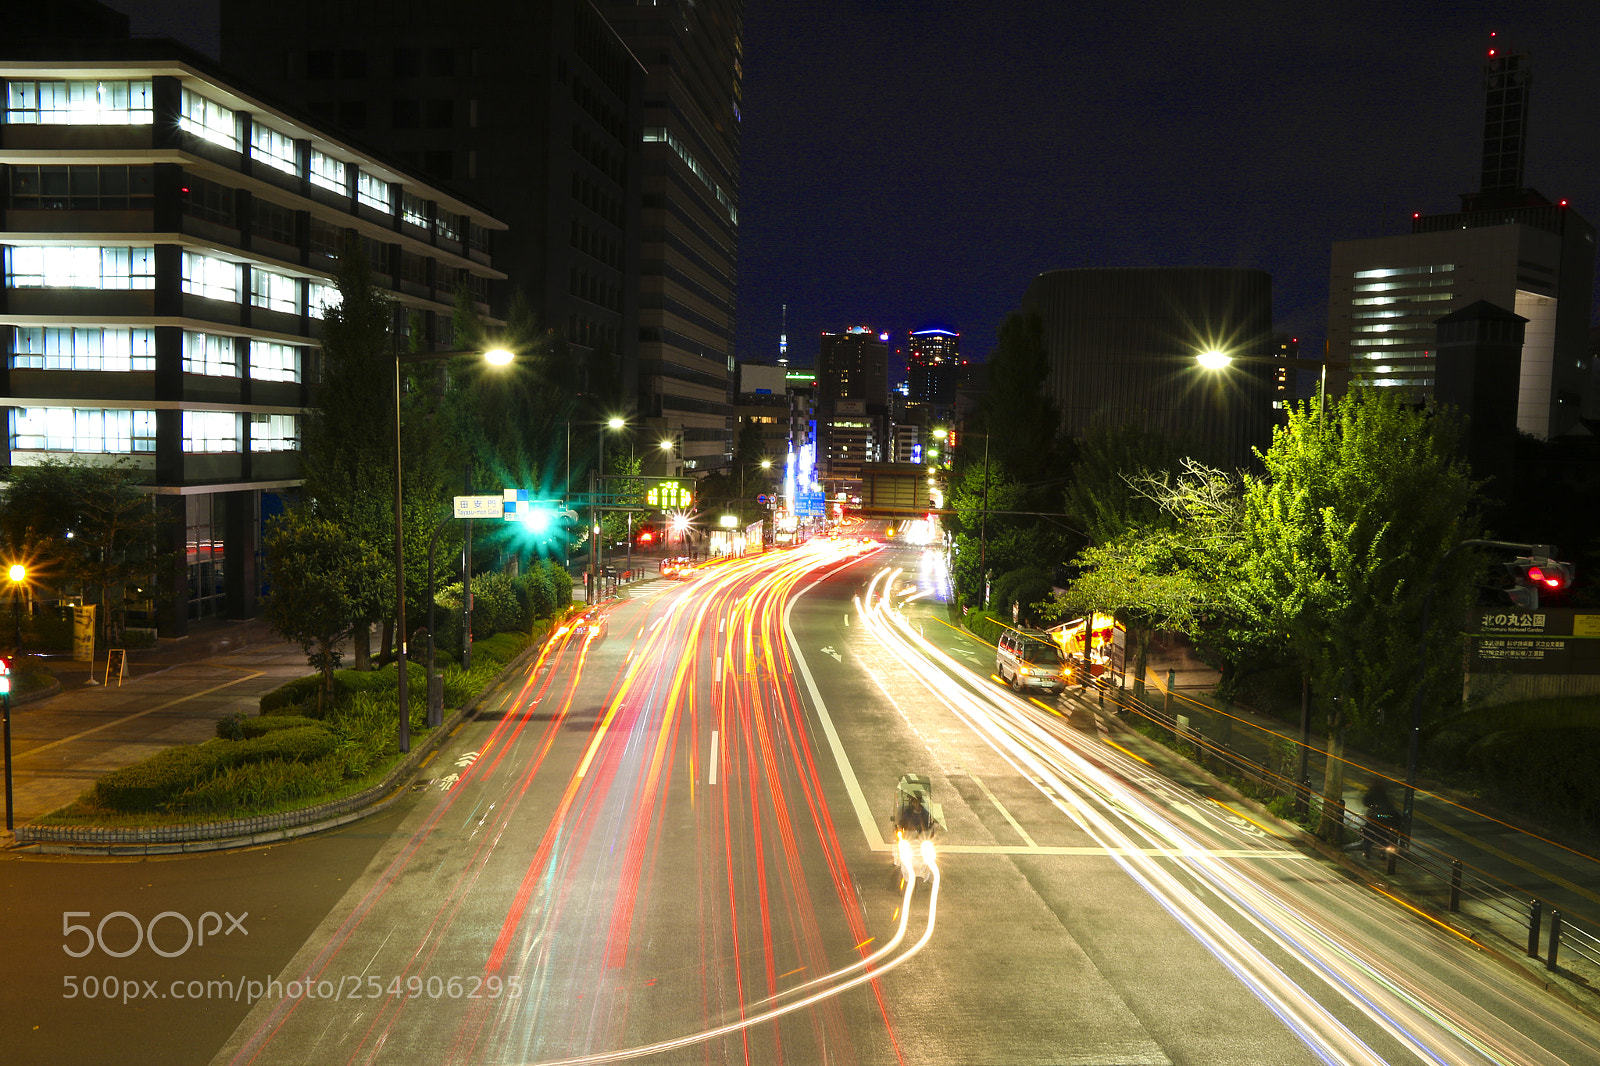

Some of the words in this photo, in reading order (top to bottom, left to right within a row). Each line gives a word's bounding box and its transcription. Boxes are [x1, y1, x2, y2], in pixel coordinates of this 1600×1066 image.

[460, 499, 496, 509] 田安門
[457, 508, 487, 516] Tayasu-mon
[1481, 613, 1546, 627] 北の丸公園
